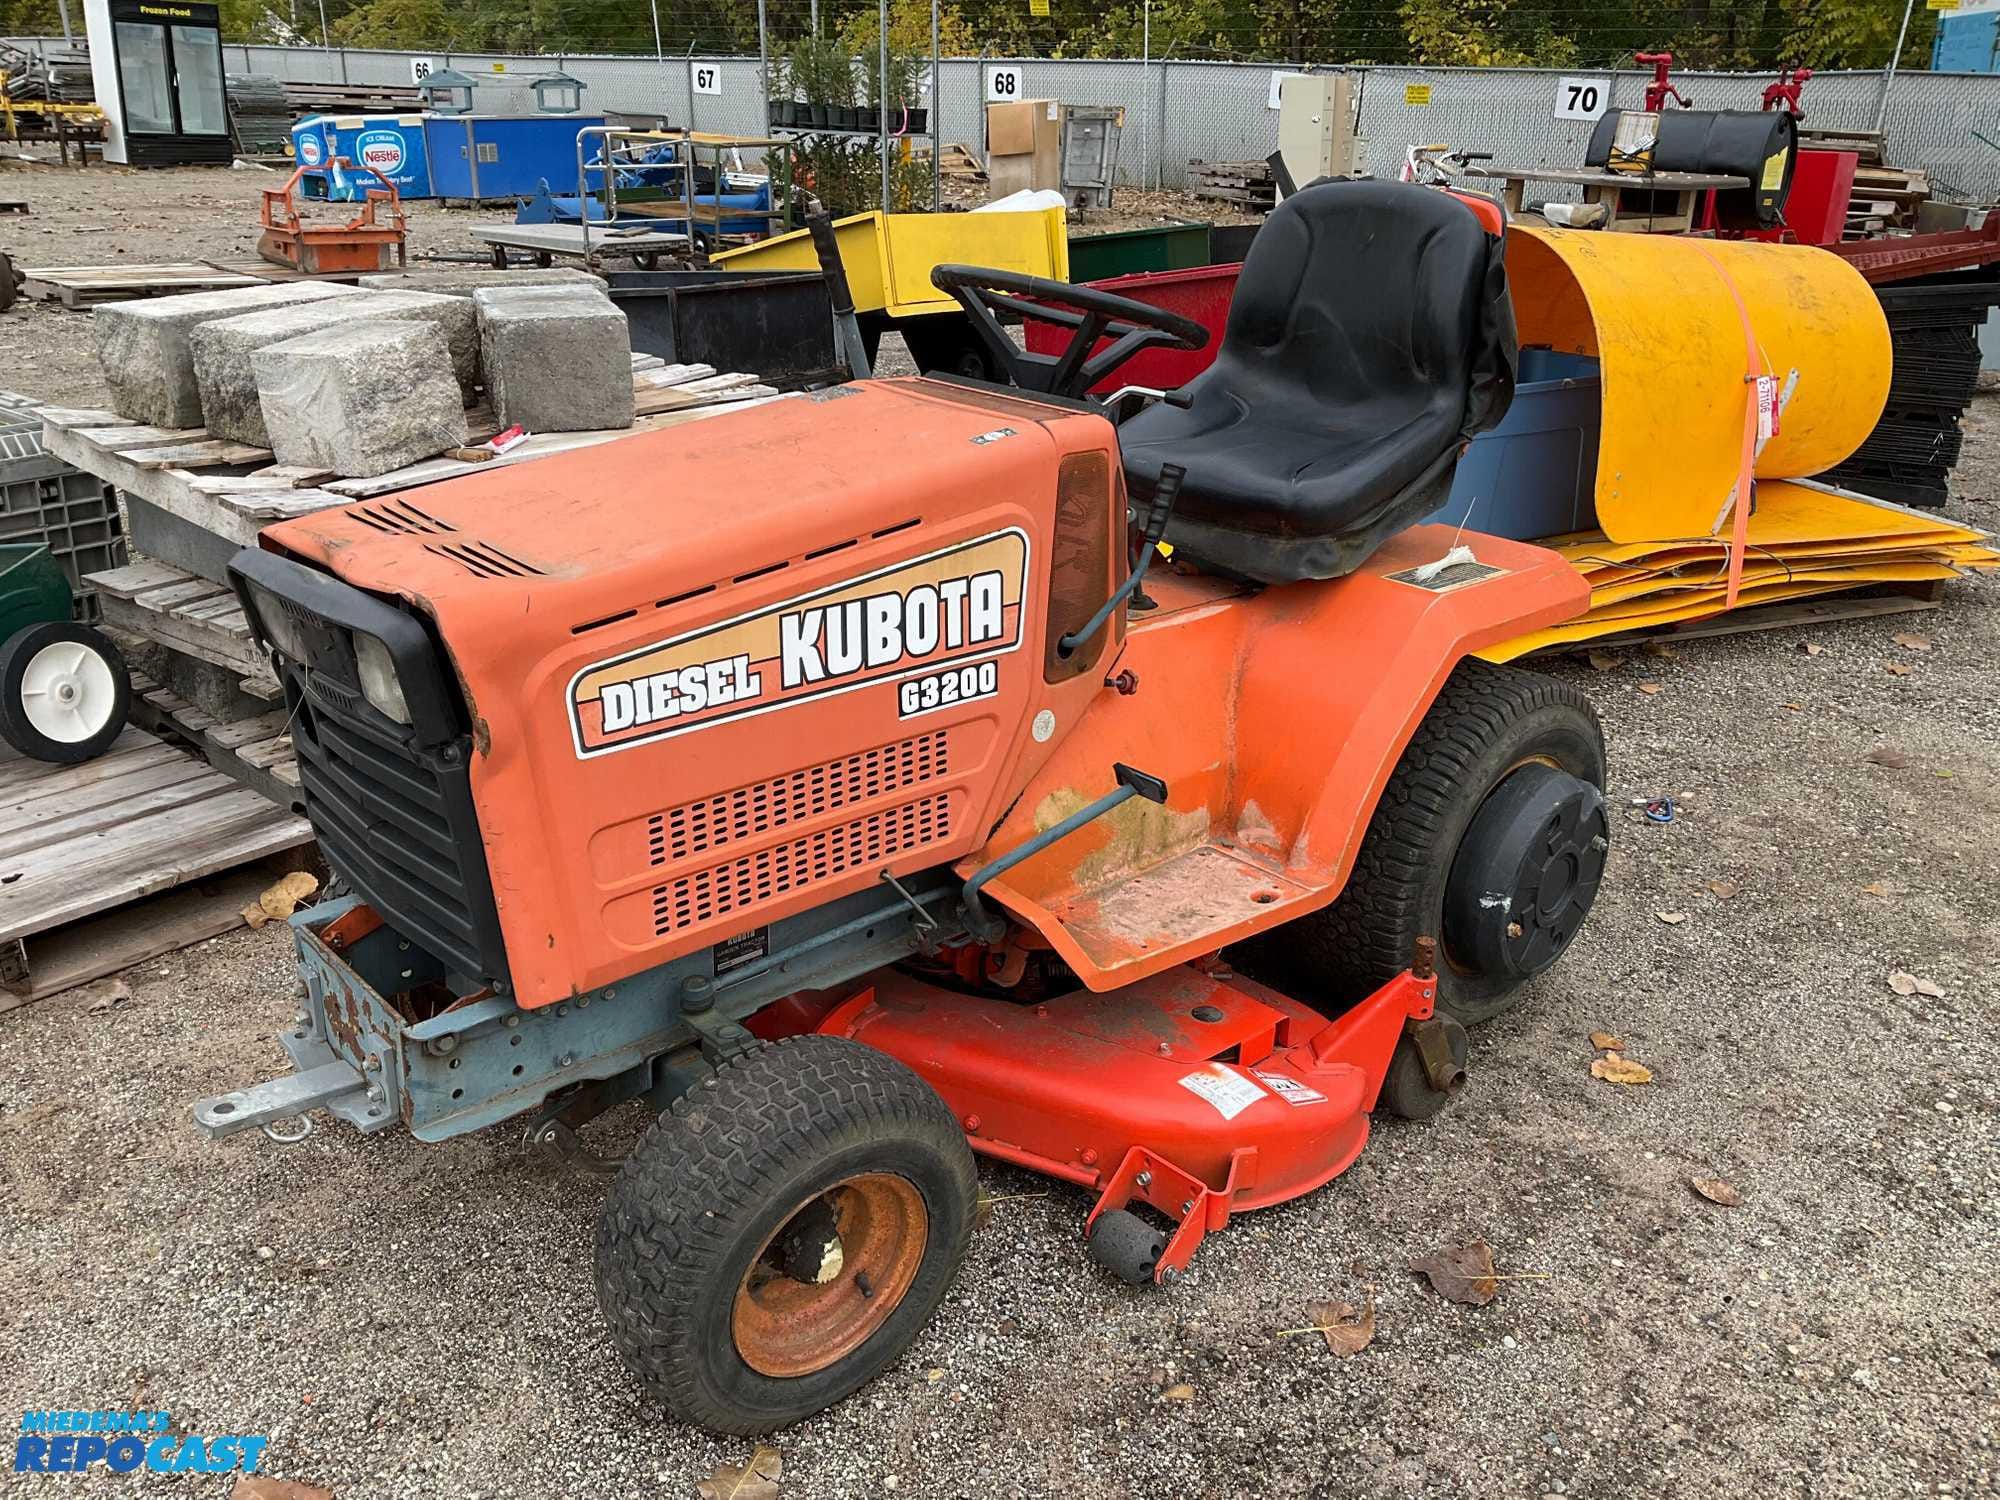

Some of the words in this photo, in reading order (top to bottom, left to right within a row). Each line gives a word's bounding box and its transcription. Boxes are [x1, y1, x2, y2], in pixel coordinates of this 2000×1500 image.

[140, 6, 168, 15] Frozen
[169, 8, 191, 16] Food
[415, 62, 430, 79] 66
[698, 69, 714, 88] 67
[995, 73, 1015, 95] 68
[1568, 86, 1598, 112] 70
[600, 654, 762, 736] DIESEL
[779, 570, 1004, 690] KUBOTA
[901, 661, 997, 715] G3200
